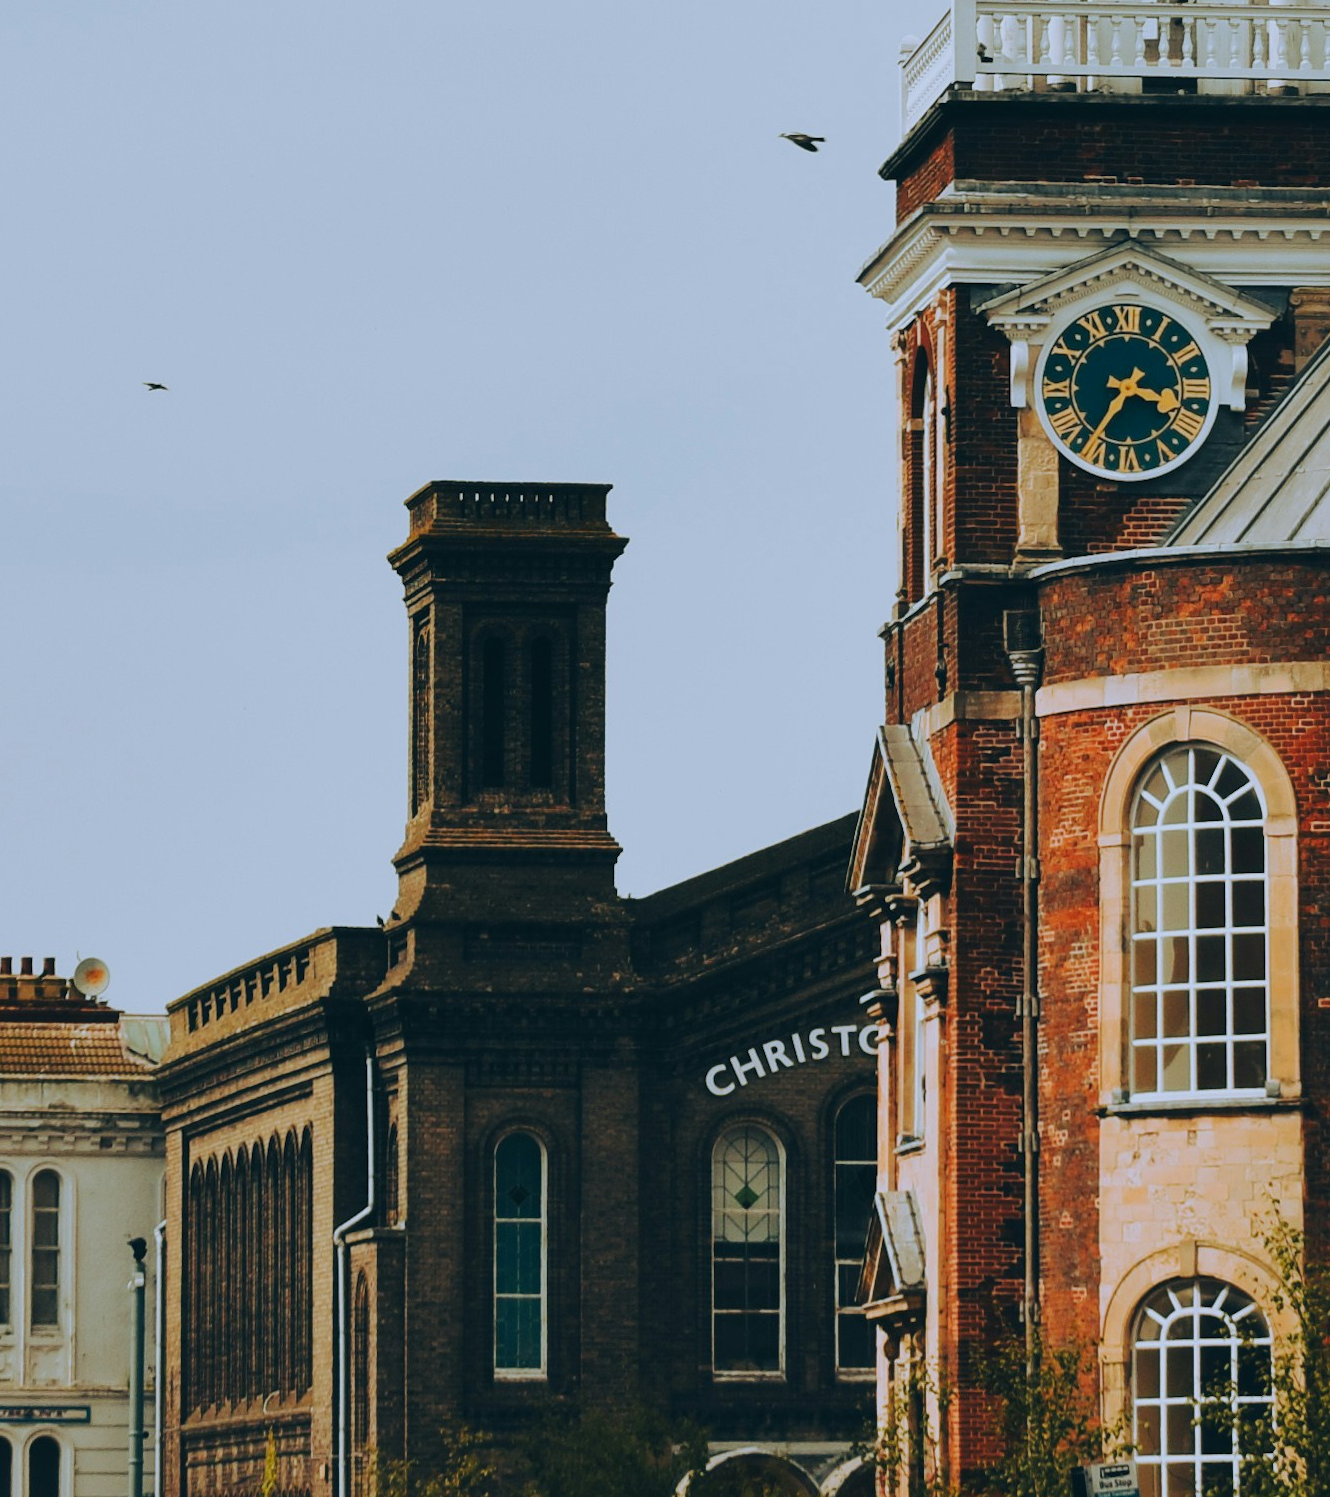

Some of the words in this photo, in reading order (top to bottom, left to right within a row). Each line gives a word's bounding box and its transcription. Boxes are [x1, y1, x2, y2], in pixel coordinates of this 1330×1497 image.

[1076, 311, 1109, 344] XI
[1112, 305, 1143, 334] XII
[1152, 316, 1172, 341] I
[1051, 336, 1083, 366] X
[1171, 341, 1201, 367] II
[1043, 376, 1070, 399] IX
[1182, 376, 1210, 400] III
[1048, 405, 1083, 447] VIII
[1170, 406, 1205, 443] IIII
[1116, 446, 1143, 472] VI
[1156, 438, 1178, 466] V
[1114, 1478, 1133, 1488] Stop
